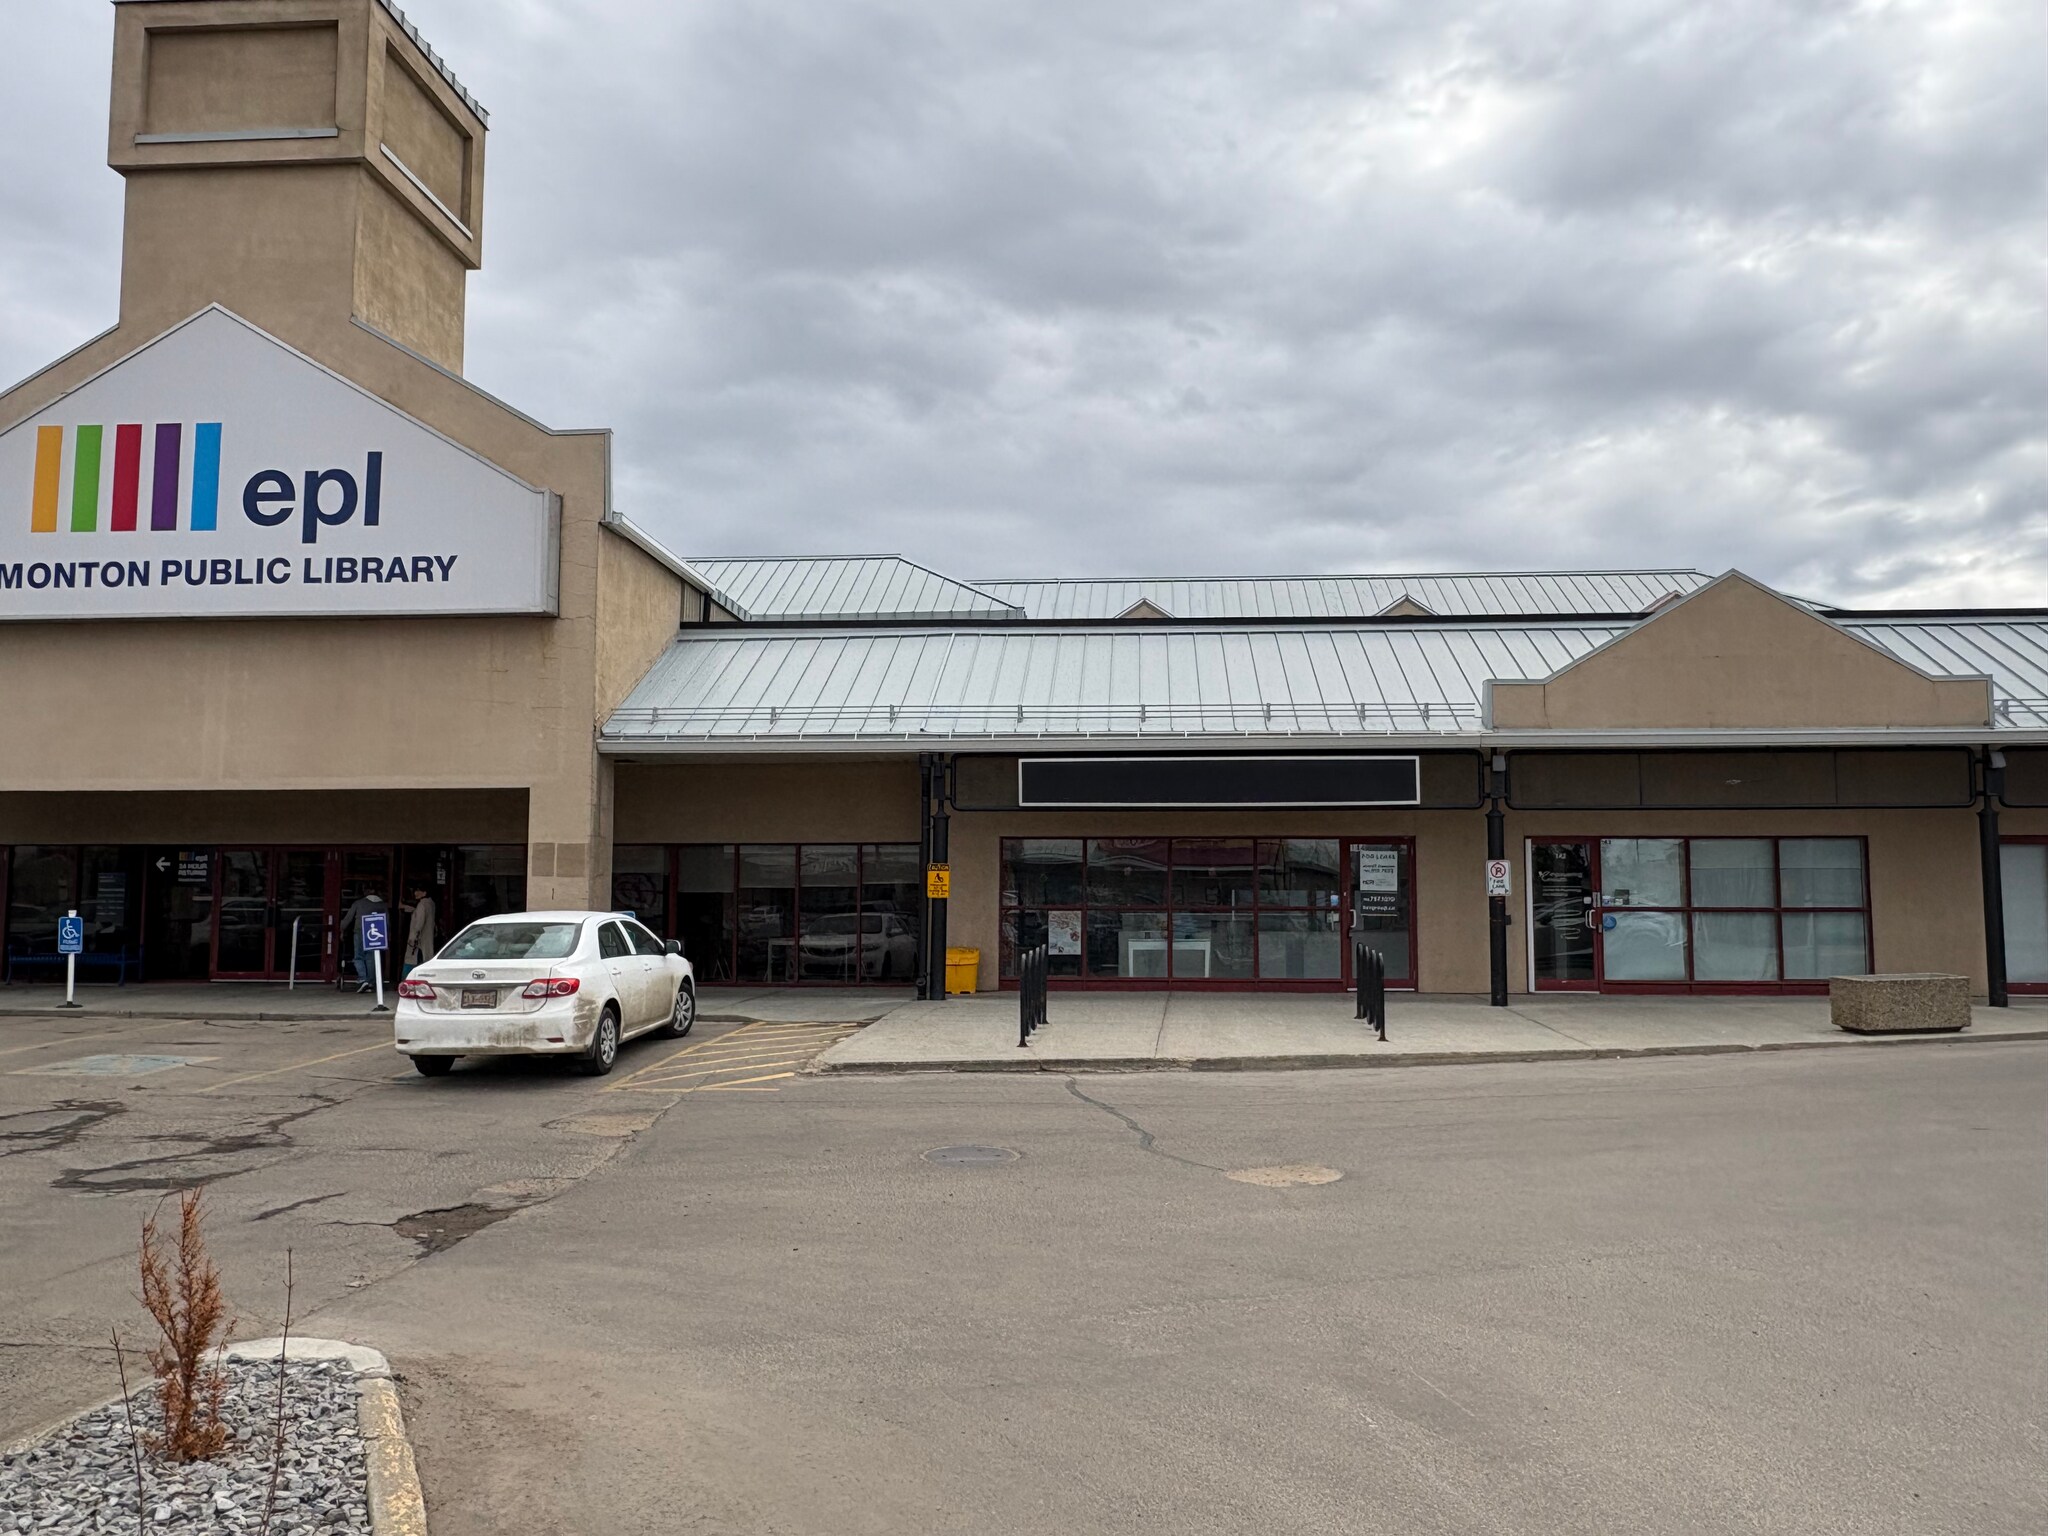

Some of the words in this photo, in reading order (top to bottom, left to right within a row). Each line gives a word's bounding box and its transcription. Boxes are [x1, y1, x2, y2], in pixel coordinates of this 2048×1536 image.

[243, 451, 383, 544] epl
[0, 560, 150, 590] MONTON
[160, 557, 292, 586] PUBLIC
[303, 554, 458, 584] LIBRARY
